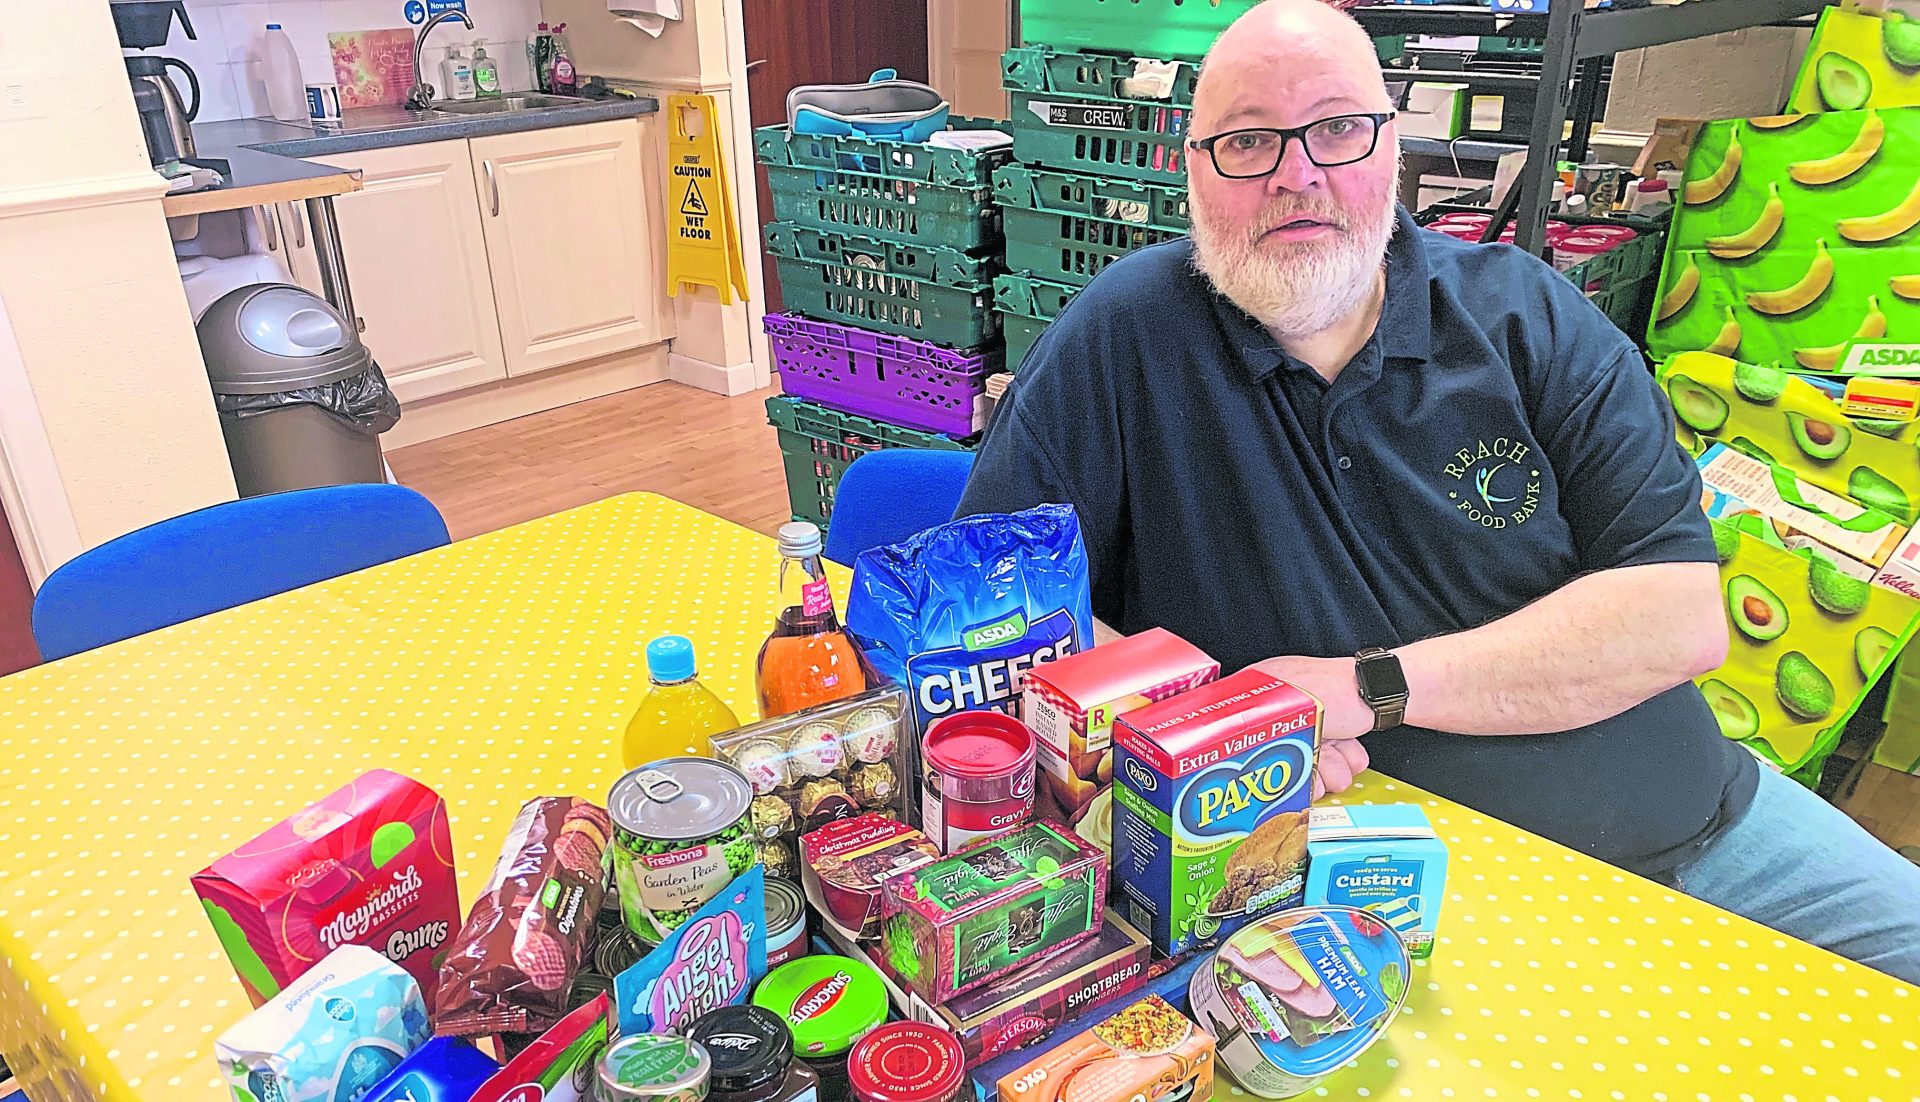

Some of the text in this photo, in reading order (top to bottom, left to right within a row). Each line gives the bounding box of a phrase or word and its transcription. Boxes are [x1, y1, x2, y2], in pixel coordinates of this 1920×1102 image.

[1050, 107, 1067, 118] M&S
[674, 166, 711, 178] CAUTION
[686, 216, 704, 227] WET
[680, 227, 711, 240] FLOOR
[1443, 437, 1531, 480] REACH
[1456, 481, 1540, 529] FOOD BANK
[806, 591, 824, 605] Real
[974, 623, 1019, 647] ASDA
[920, 636, 1073, 715] CHEESE
[1037, 701, 1056, 719] TESCO
[1094, 709, 1105, 726] R
[1146, 680, 1284, 733] MAKES 24 STUFFING BALLS
[1036, 711, 1057, 730] INSTANT
[1036, 717, 1057, 737] MASHED
[1036, 724, 1056, 743] POTATO
[1131, 736, 1147, 751] MAKES
[1123, 739, 1161, 767] STUFFING BALLS
[1178, 750, 1220, 774] Extra
[1224, 729, 1266, 755] Value
[1129, 763, 1152, 787] PAXO
[1124, 787, 1136, 801] Sage
[1141, 801, 1158, 817] Onion
[1198, 760, 1292, 828] PAXO
[990, 807, 1025, 826] Gravy
[819, 836, 861, 855] Christmas
[861, 825, 896, 842] Pudding
[1001, 838, 1049, 860] After
[1193, 844, 1214, 853] FAVOURITE
[646, 848, 703, 867] Freshona
[1187, 856, 1217, 873] Sage &
[643, 862, 719, 888] Garden Peas
[935, 865, 989, 888] Eight
[1189, 867, 1215, 881] Onion
[1336, 873, 1414, 888] Custard
[666, 882, 705, 898] in Water
[320, 864, 423, 950] Maynards
[372, 892, 419, 927] BASSETTS
[558, 885, 585, 935] Digestives
[1036, 892, 1083, 924] After
[387, 920, 449, 961] Gums
[972, 918, 1017, 952] Eight
[662, 917, 730, 1027] Angel
[1317, 936, 1366, 1000] PREMIUM LEAN
[1345, 949, 1363, 975] ASDA
[1316, 956, 1346, 991] HAM
[285, 973, 336, 1013] Granulated
[1068, 962, 1141, 1008] SHORTBREAD
[1086, 984, 1122, 1005] FINGERS
[665, 959, 739, 1034] elight
[786, 970, 853, 1026] SNACKRITE
[1268, 993, 1281, 1009] 340g
[709, 1037, 758, 1051] Deluxe
[880, 1031, 903, 1044] SINCE
[905, 1031, 924, 1039] 1930
[865, 1041, 881, 1063] OWNED
[931, 1038, 948, 1060] FARMER
[1195, 1052, 1208, 1066] x4
[630, 1048, 681, 1083] real fruit
[863, 1062, 881, 1084] FARMER
[932, 1060, 949, 1082] OWNED
[910, 1079, 933, 1092] SINCE
[1013, 1068, 1048, 1093] OXO
[940, 1089, 955, 1102] EASY
